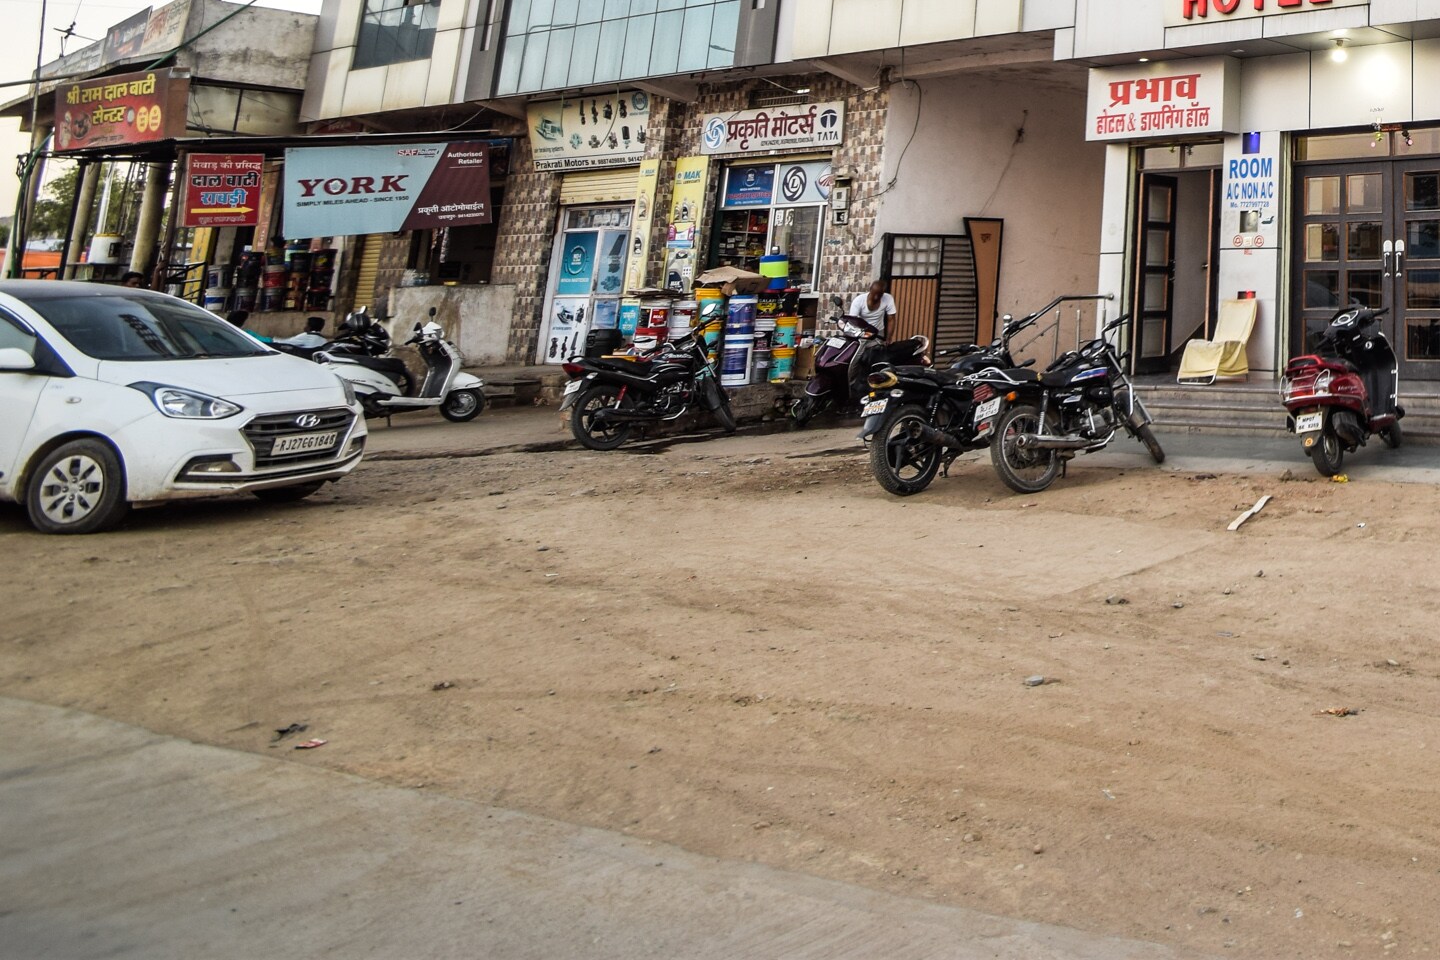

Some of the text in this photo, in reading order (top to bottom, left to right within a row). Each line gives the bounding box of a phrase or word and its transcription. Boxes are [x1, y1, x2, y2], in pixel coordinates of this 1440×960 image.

[66, 73, 156, 105] श्री राम दाल बाटी
[1108, 73, 1201, 107] प्रभाव
[91, 104, 127, 125] सेन्टर
[1096, 101, 1211, 134] होटल & डायनिंग हॉल
[726, 112, 771, 150] प्रकृति
[817, 130, 839, 142] TATA
[220, 159, 233, 169] की
[235, 160, 262, 170] प्रसिद्ध
[535, 160, 563, 170] Prakrati
[564, 158, 590, 168] Motors
[1229, 157, 1273, 179] ROOM
[191, 170, 260, 187] दाल बाटी
[683, 170, 702, 180] MAK
[297, 174, 409, 198] YORK
[1226, 181, 1274, 200] A/C NON A/C
[297, 199, 322, 207] SIMPLY
[323, 198, 344, 206] MILES
[345, 197, 369, 205] AHEAD
